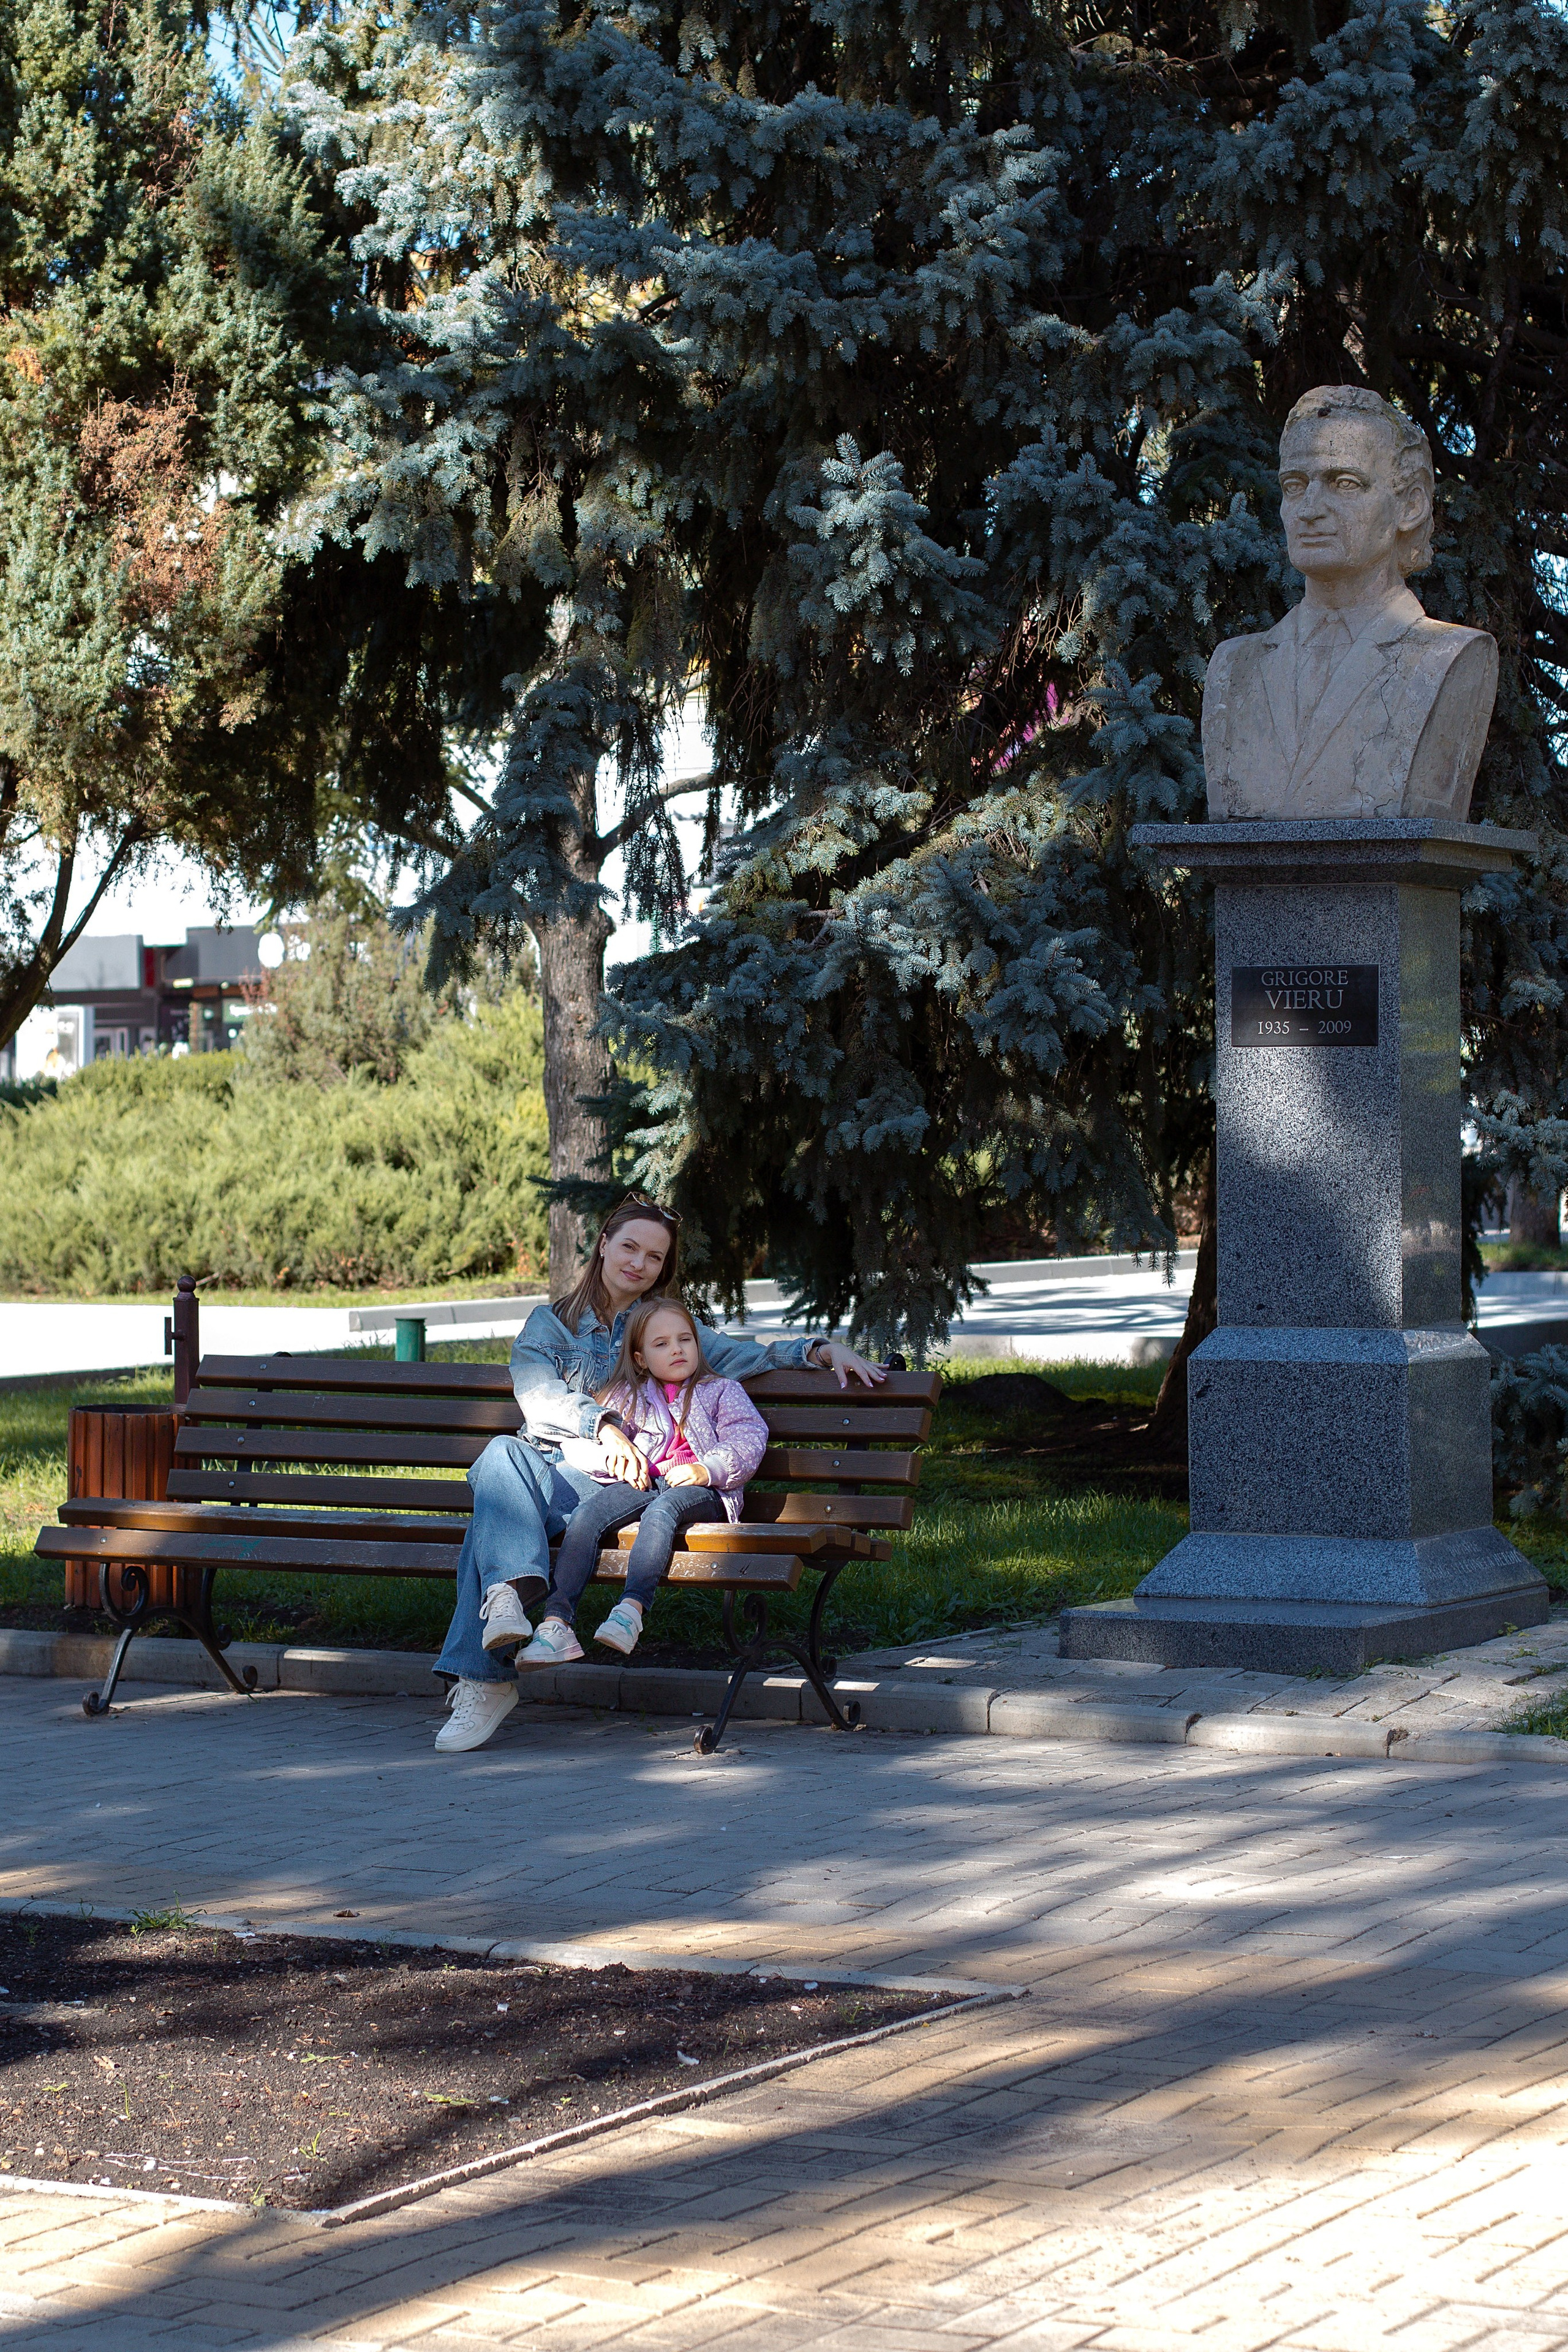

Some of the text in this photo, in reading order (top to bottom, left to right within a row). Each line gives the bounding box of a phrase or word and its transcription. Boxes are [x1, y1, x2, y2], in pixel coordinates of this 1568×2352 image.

[1261, 970, 1348, 986] GRIGORE
[1265, 989, 1343, 1009] VIERU
[1257, 1020, 1290, 1035] 1935
[1317, 1020, 1352, 1034] 2009
